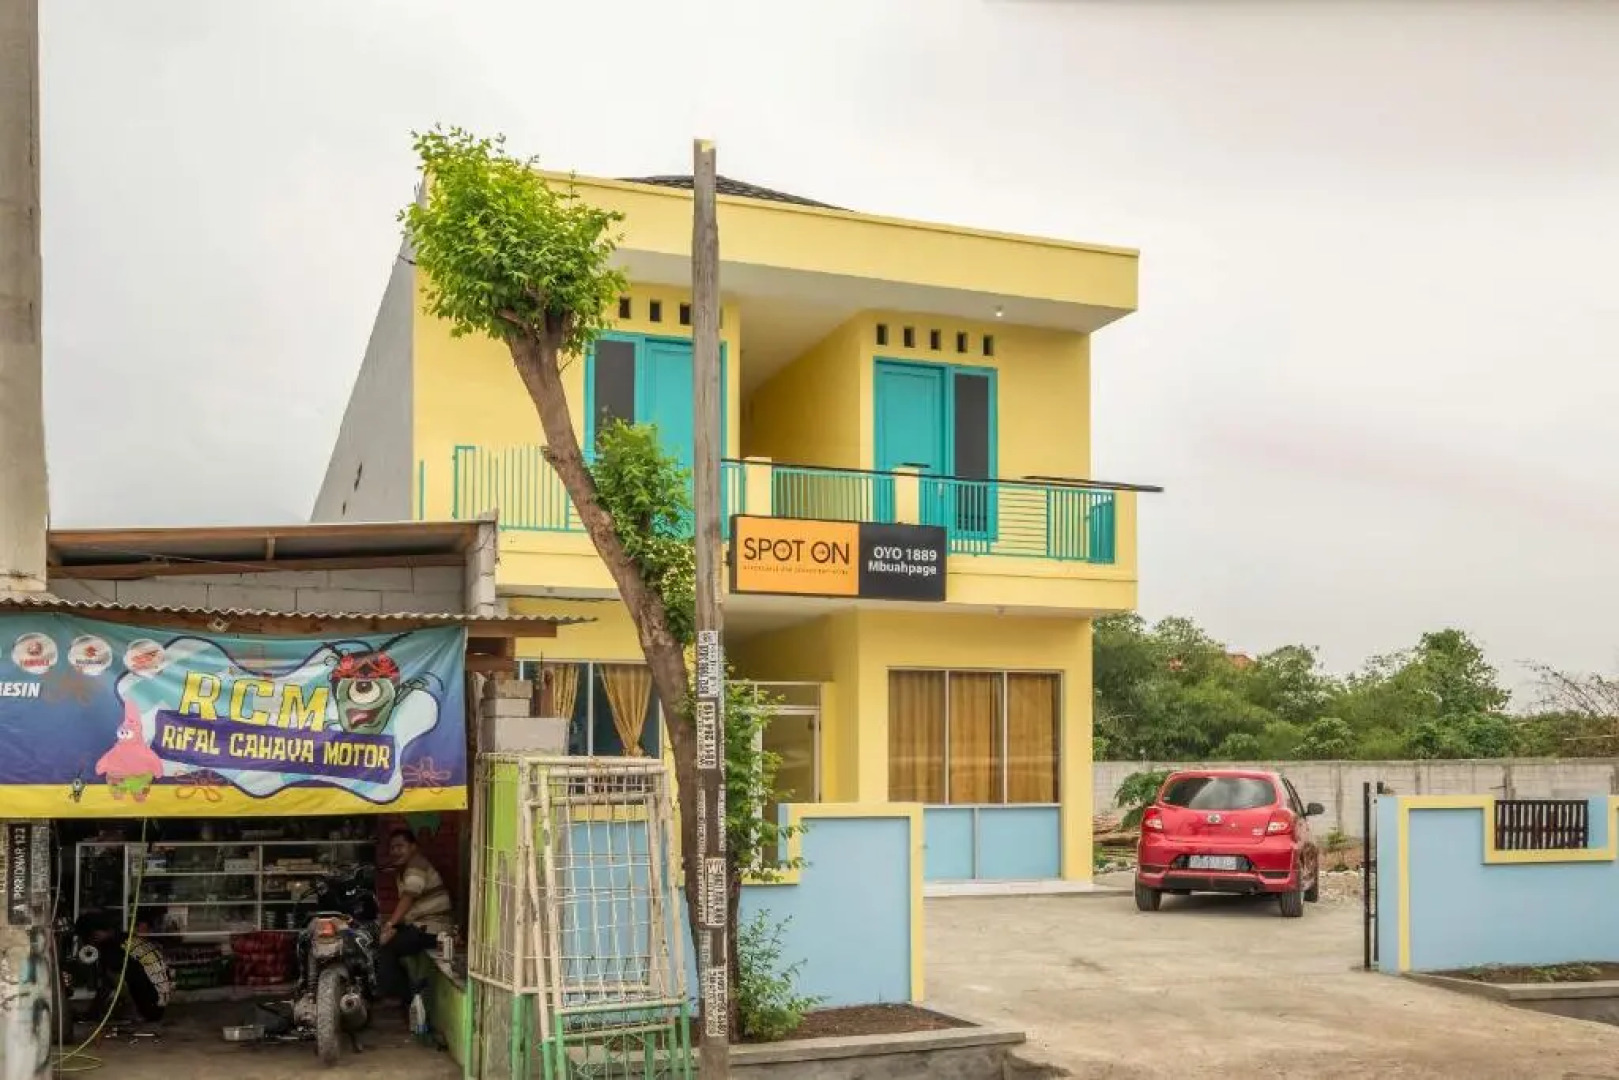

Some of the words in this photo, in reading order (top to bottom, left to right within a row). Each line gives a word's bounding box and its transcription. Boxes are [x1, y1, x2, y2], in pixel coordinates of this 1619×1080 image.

[744, 537, 805, 563] SPOT
[810, 540, 850, 565] ON
[873, 546, 902, 560] OYO
[906, 548, 937, 562] 1889
[868, 560, 937, 576] Mbuahpage
[179, 670, 329, 732] RCM
[229, 733, 314, 763] CAHAYA
[323, 741, 390, 769] MOTOR
